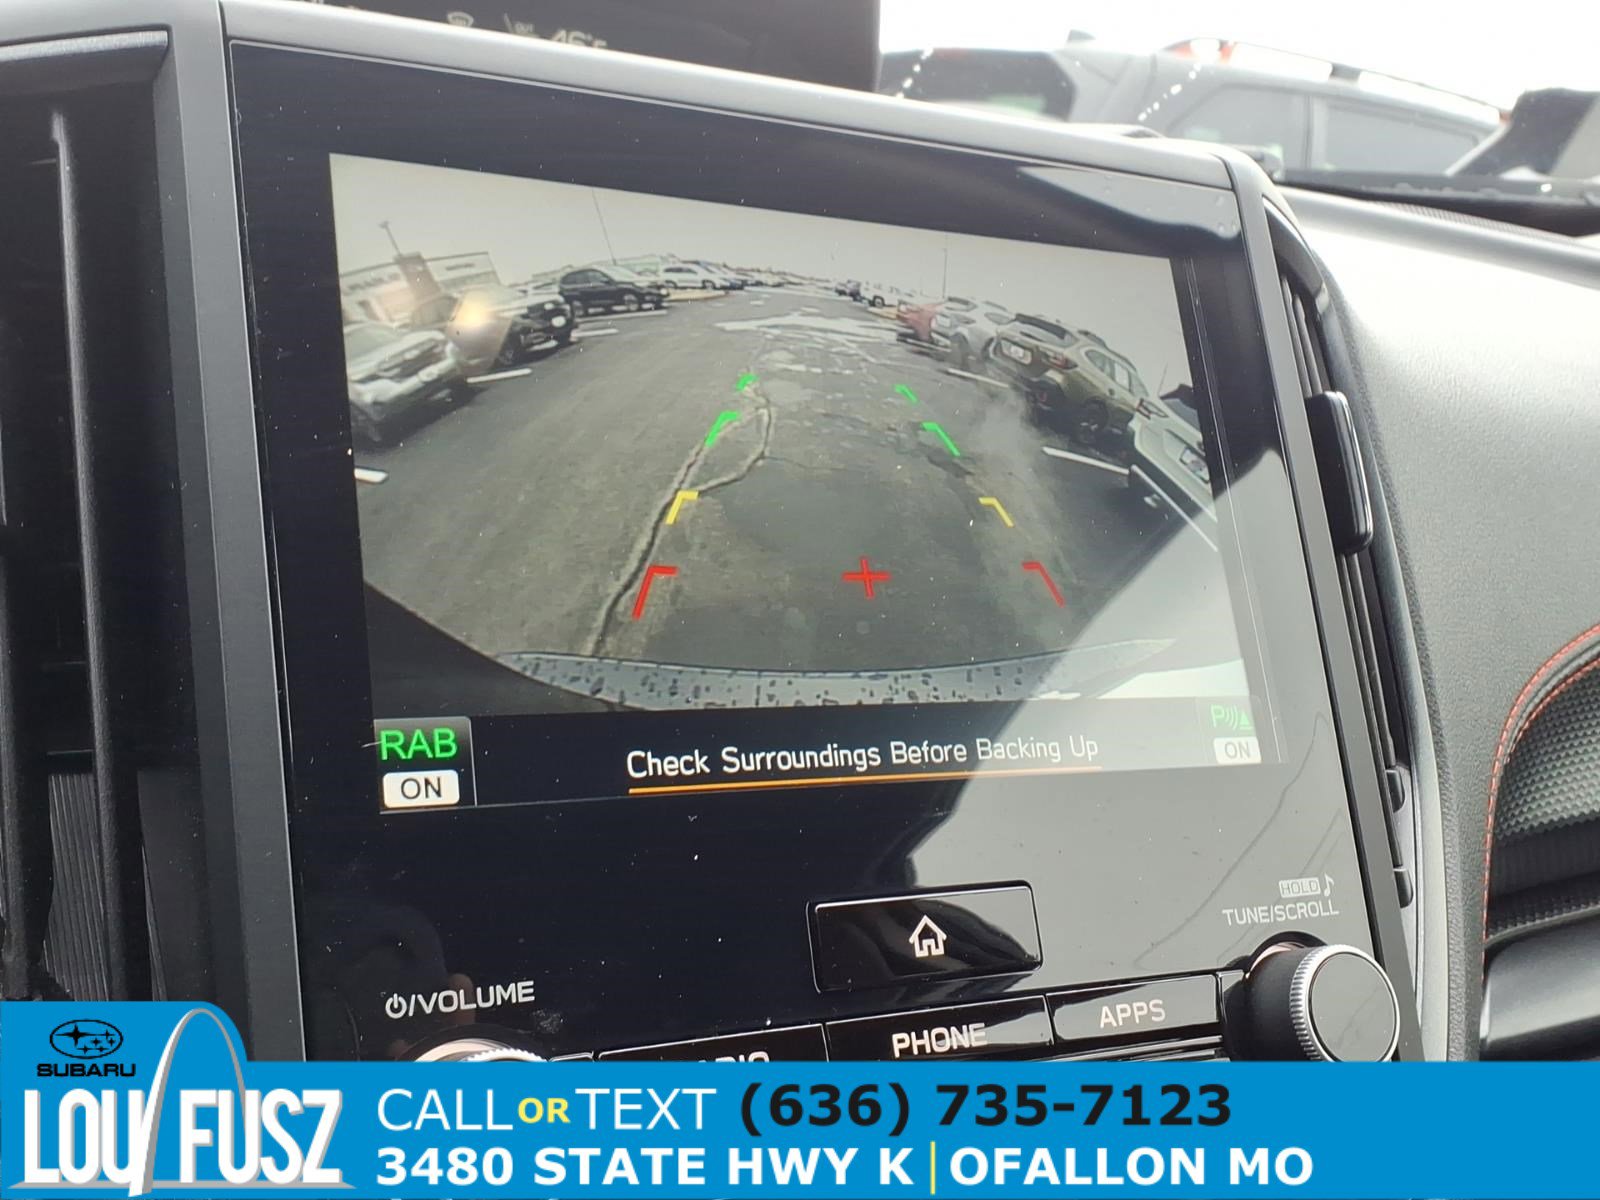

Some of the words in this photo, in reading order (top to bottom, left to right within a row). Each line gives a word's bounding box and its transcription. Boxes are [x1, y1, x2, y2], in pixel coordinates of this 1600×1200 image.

[379, 727, 458, 761] RAB
[626, 745, 711, 779] Check
[721, 742, 882, 773] Surroundings
[889, 739, 968, 765] Before
[975, 736, 1062, 763] Backing
[1069, 734, 1100, 760] Up
[1224, 741, 1251, 759] ON
[400, 777, 443, 800] ON
[1279, 877, 1321, 898] HOLD
[1221, 899, 1341, 926] TUNE/SCROLL
[1099, 999, 1167, 1029] APPS
[891, 1022, 989, 1059] PHONE
